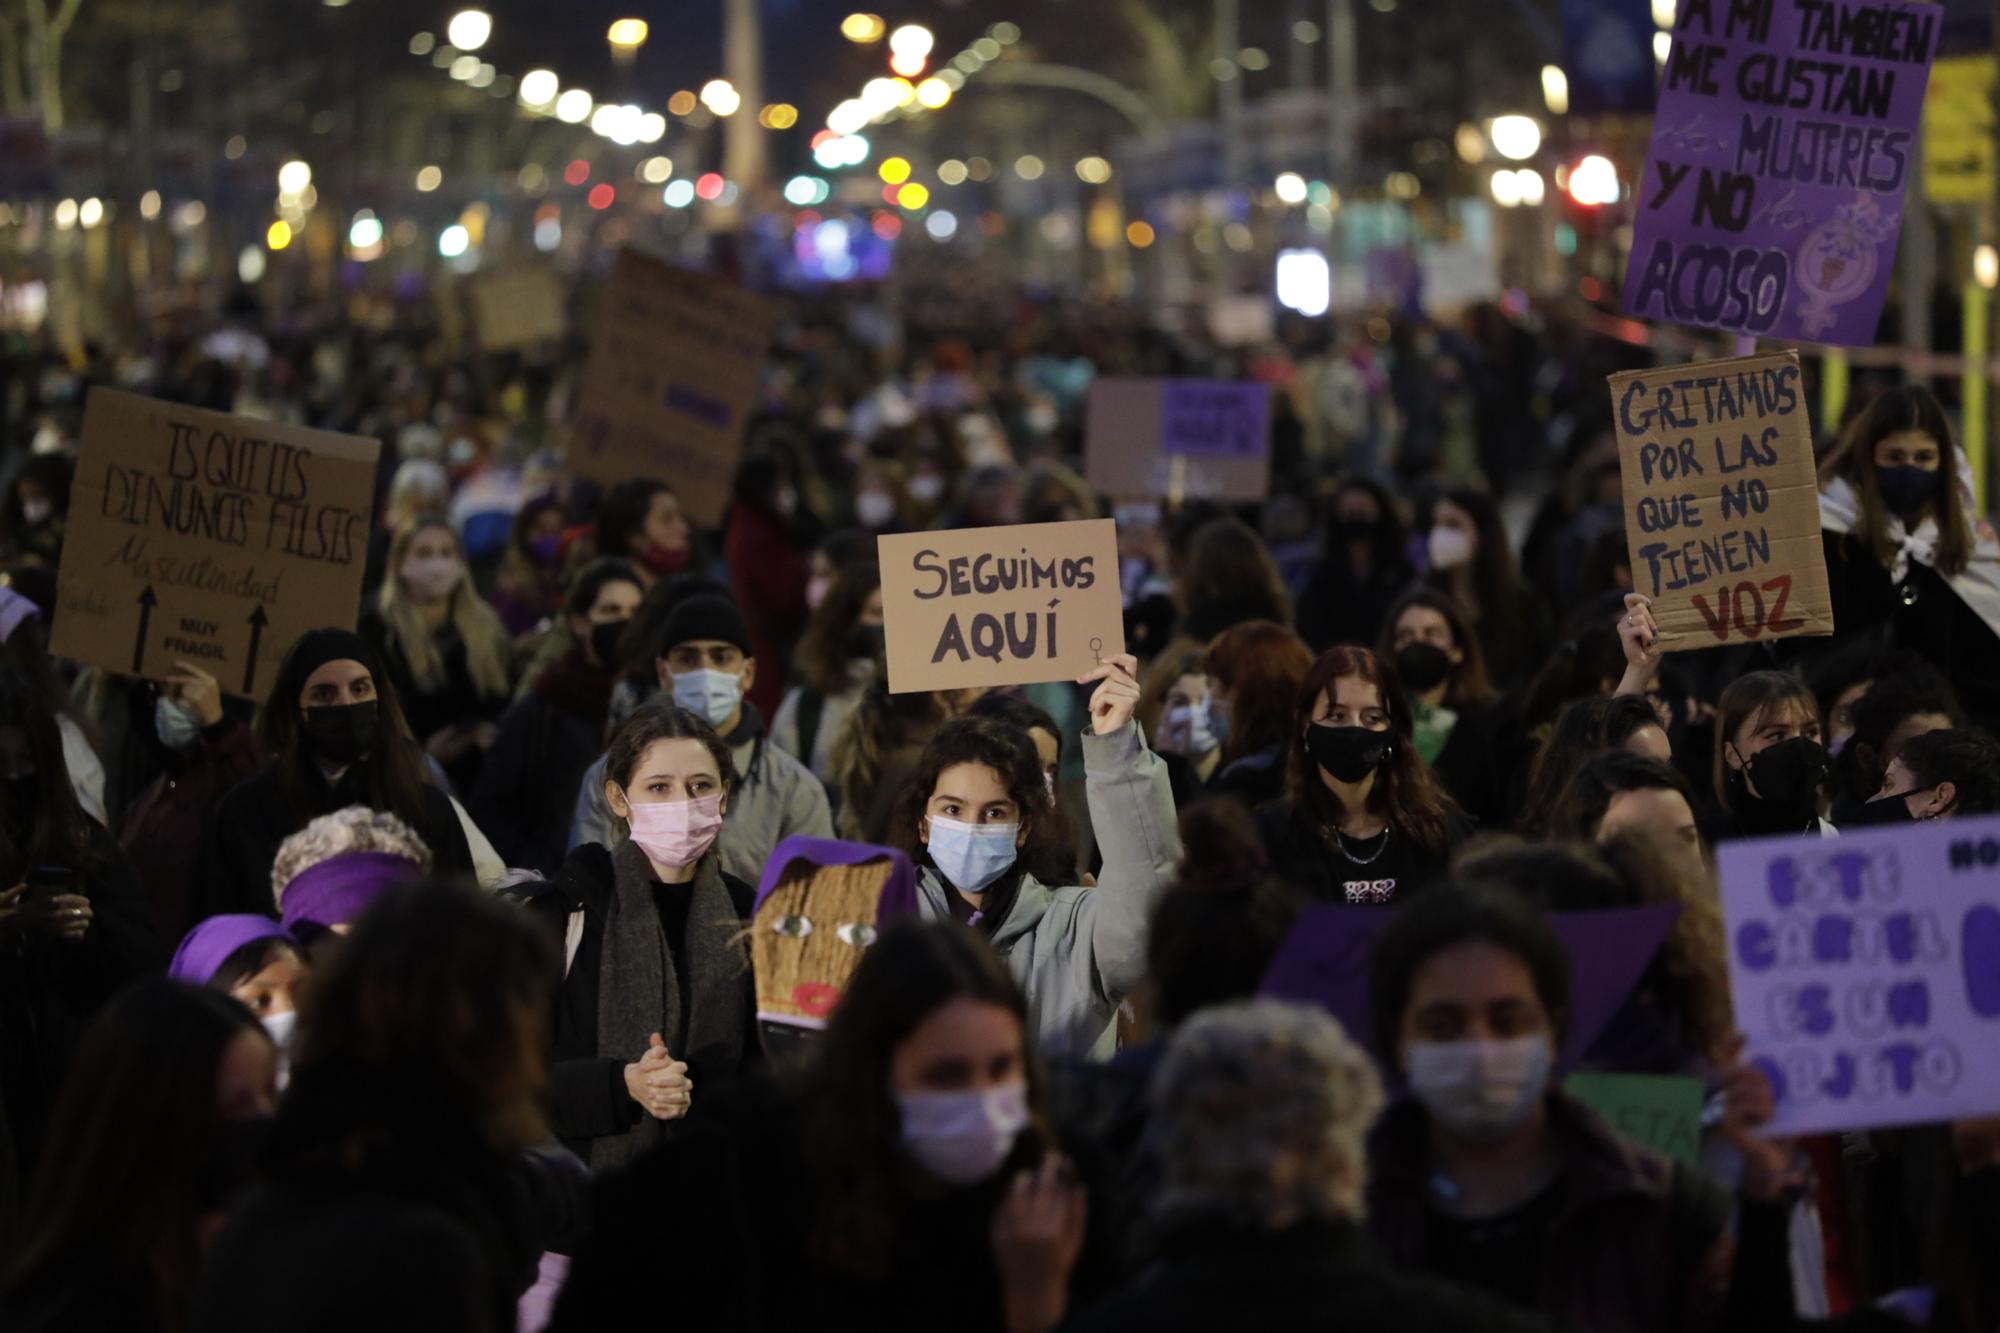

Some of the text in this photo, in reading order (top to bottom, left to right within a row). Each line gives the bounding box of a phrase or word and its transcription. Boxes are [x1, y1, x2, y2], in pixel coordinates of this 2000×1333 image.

[1680, 0, 1712, 35] A
[1725, 0, 1774, 44] MI
[1668, 41, 1895, 119] ME GUSTAN
[1736, 112, 1911, 194] MUJERES
[1648, 160, 1692, 210] Y
[1691, 168, 1756, 232] NO
[1632, 240, 1790, 336] ACOSO
[1619, 365, 1799, 437] GRITAMOS
[1640, 427, 1779, 486] POR LAS
[1637, 478, 1770, 533] QUE NO
[1639, 527, 1771, 598] TIENEN
[179, 617, 219, 636] MUY
[931, 598, 1061, 664] AQUÍ
[1692, 574, 1805, 642] VOZ
